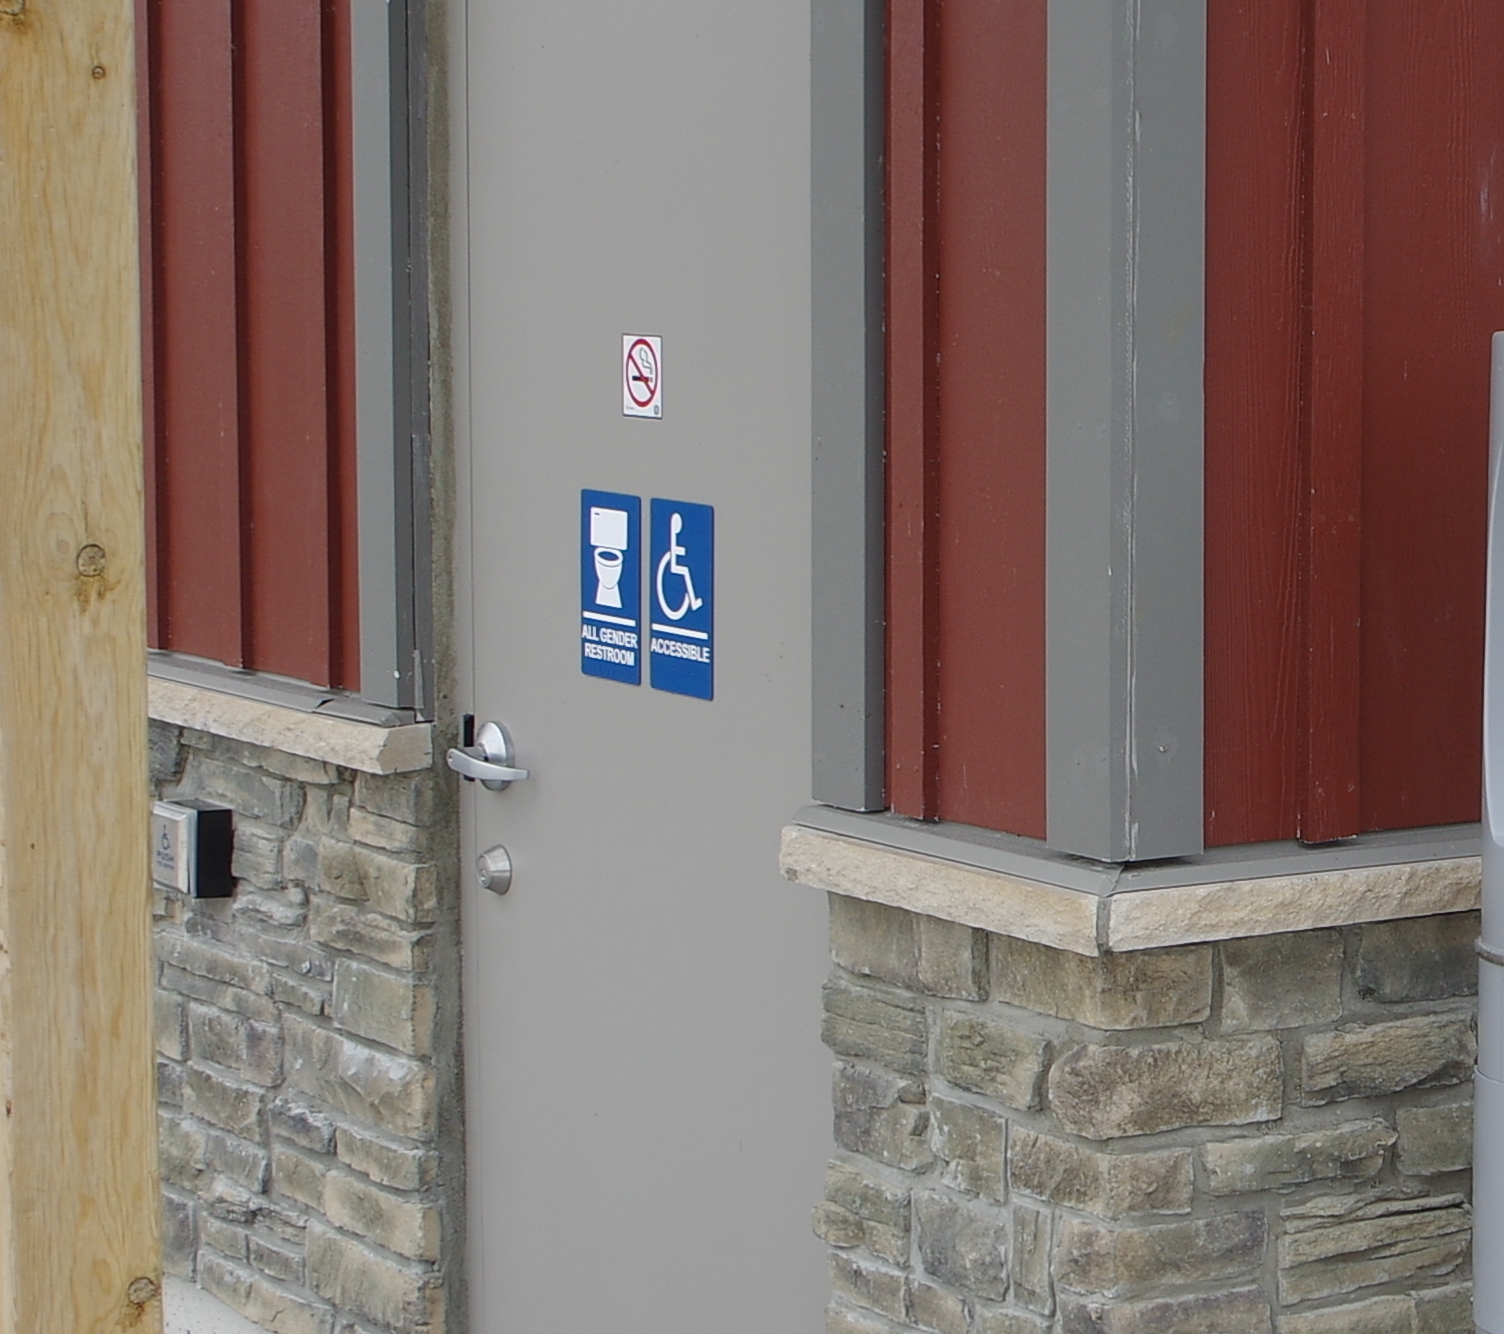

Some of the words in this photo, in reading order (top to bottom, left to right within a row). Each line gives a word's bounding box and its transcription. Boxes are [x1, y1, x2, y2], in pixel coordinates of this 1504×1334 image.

[582, 624, 599, 641] ALL
[600, 627, 638, 649] GENDER
[584, 642, 635, 667] RESTROOM
[650, 637, 711, 663] ACCESSIBLE
[156, 850, 174, 863] PUSH
